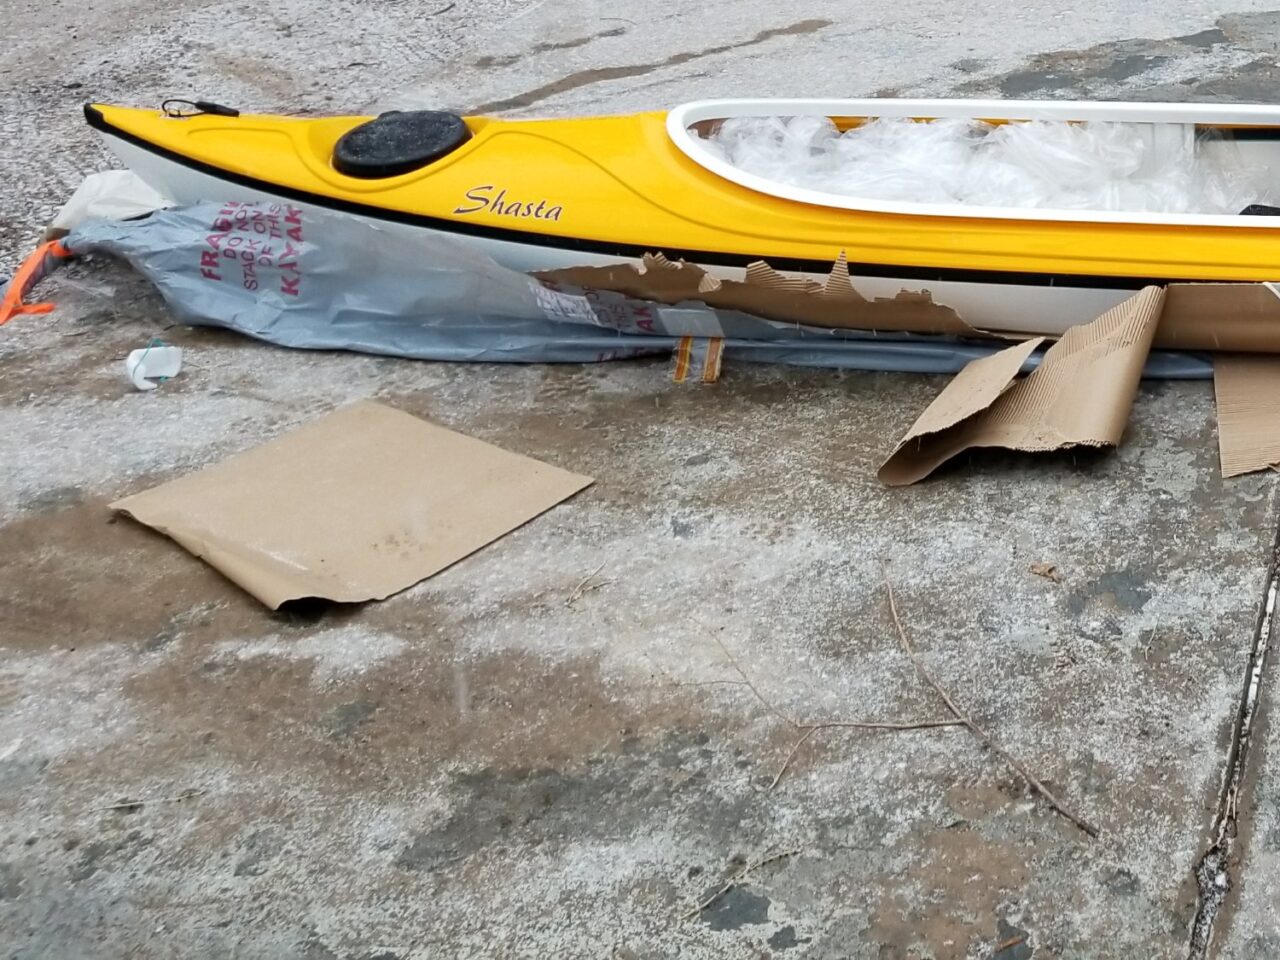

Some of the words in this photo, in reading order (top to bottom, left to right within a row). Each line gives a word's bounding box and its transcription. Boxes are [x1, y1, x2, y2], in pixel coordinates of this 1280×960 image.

[223, 237, 243, 259] DO
[234, 202, 254, 232] NOT
[453, 186, 562, 221] Shasta
[240, 239, 262, 291] STACK
[251, 210, 266, 234] ON
[258, 244, 274, 267] OF
[267, 204, 282, 239] THIS
[278, 206, 304, 296] KAYAK
